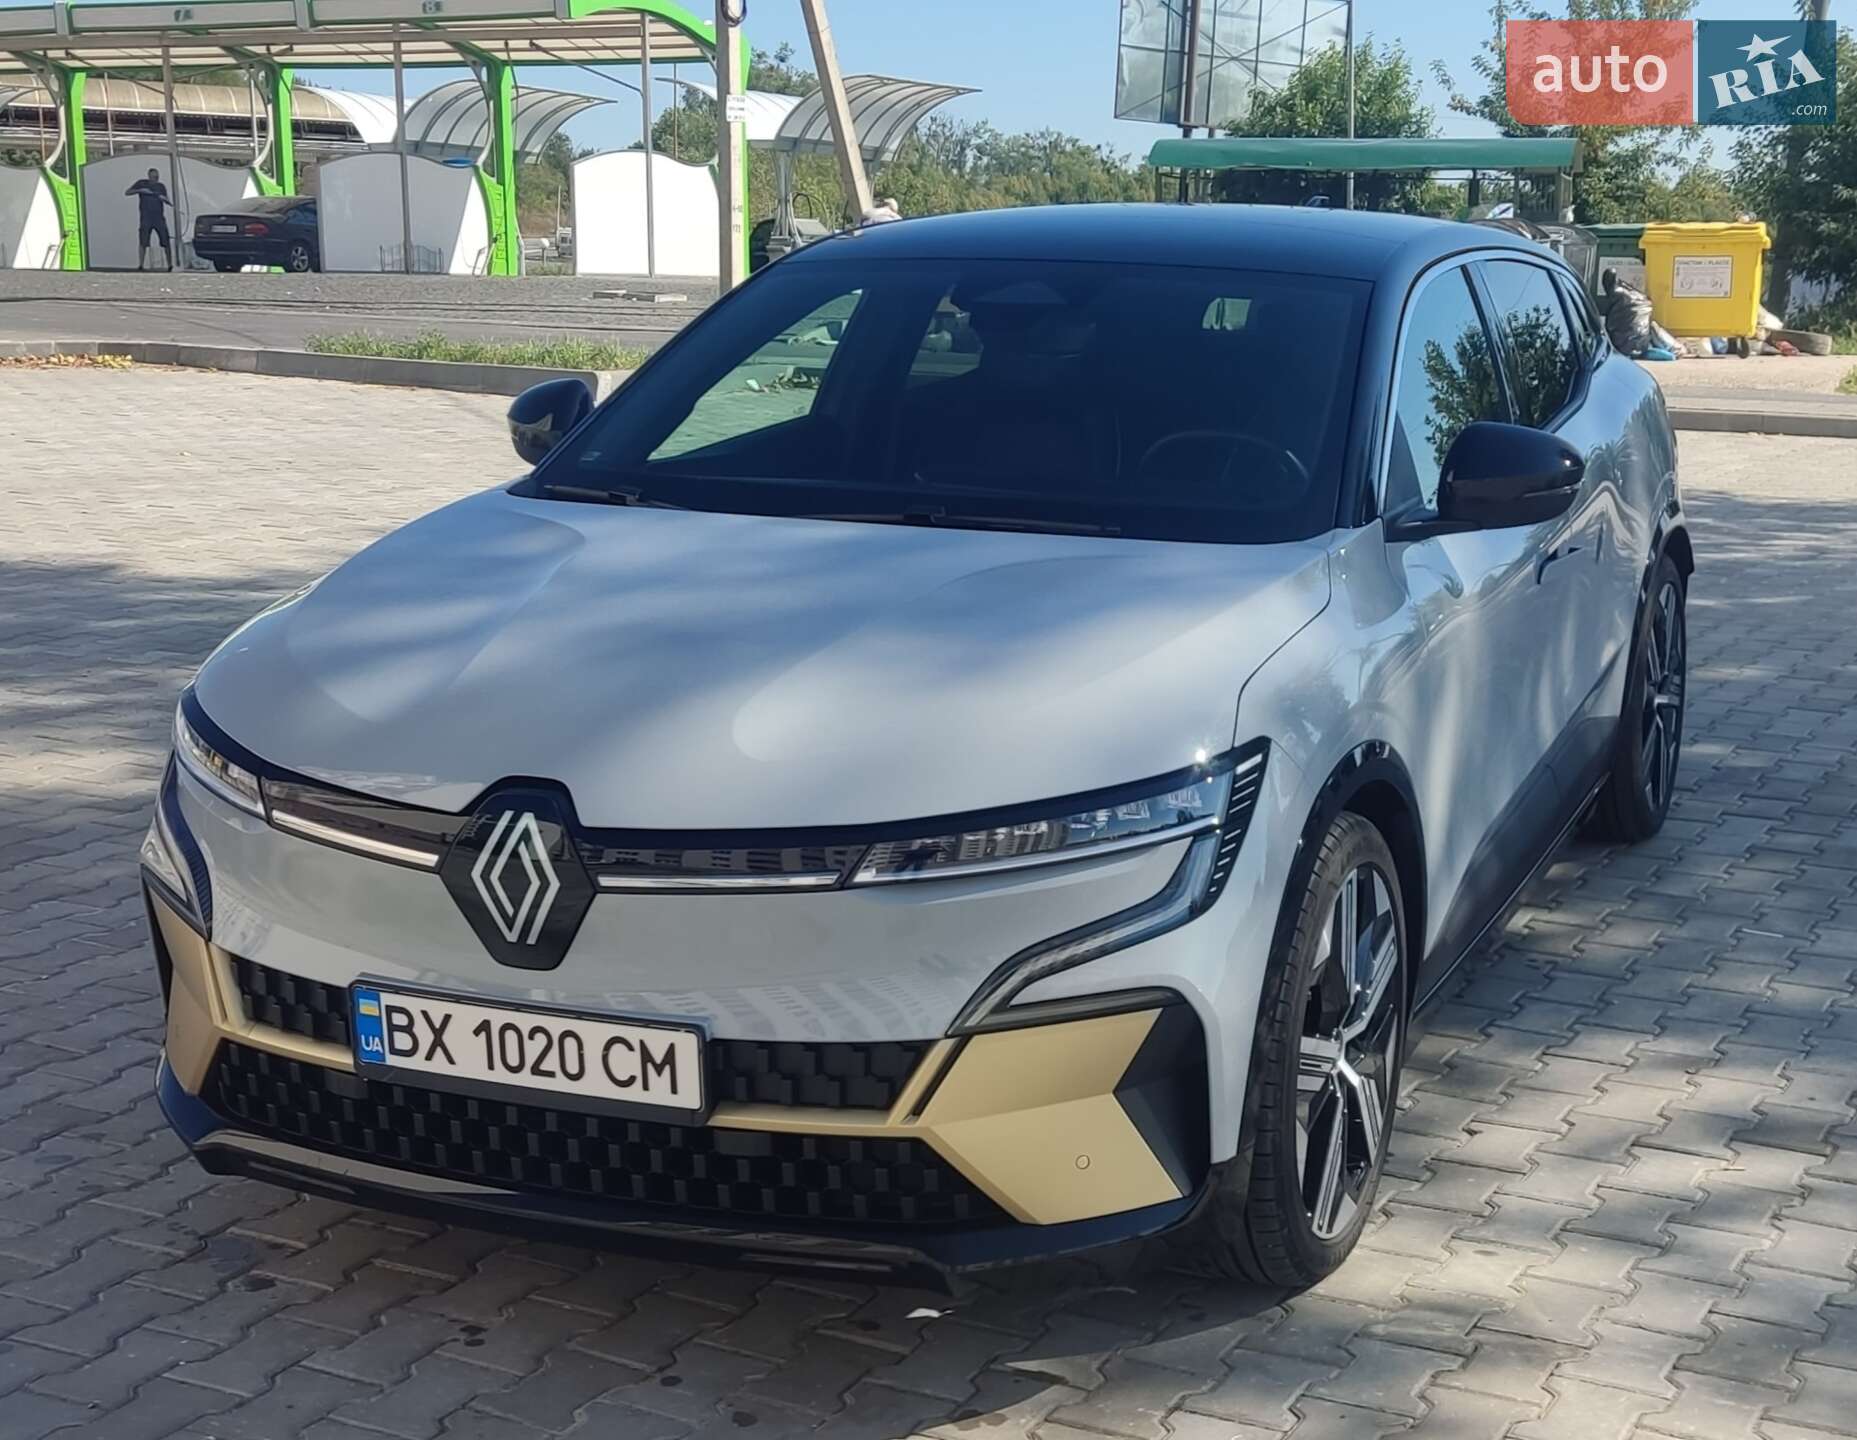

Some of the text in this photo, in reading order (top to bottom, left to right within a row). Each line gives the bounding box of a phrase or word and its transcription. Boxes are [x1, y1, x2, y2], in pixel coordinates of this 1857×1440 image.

[361, 1034, 383, 1054] UA
[385, 1004, 678, 1095] BX 1020 CM
